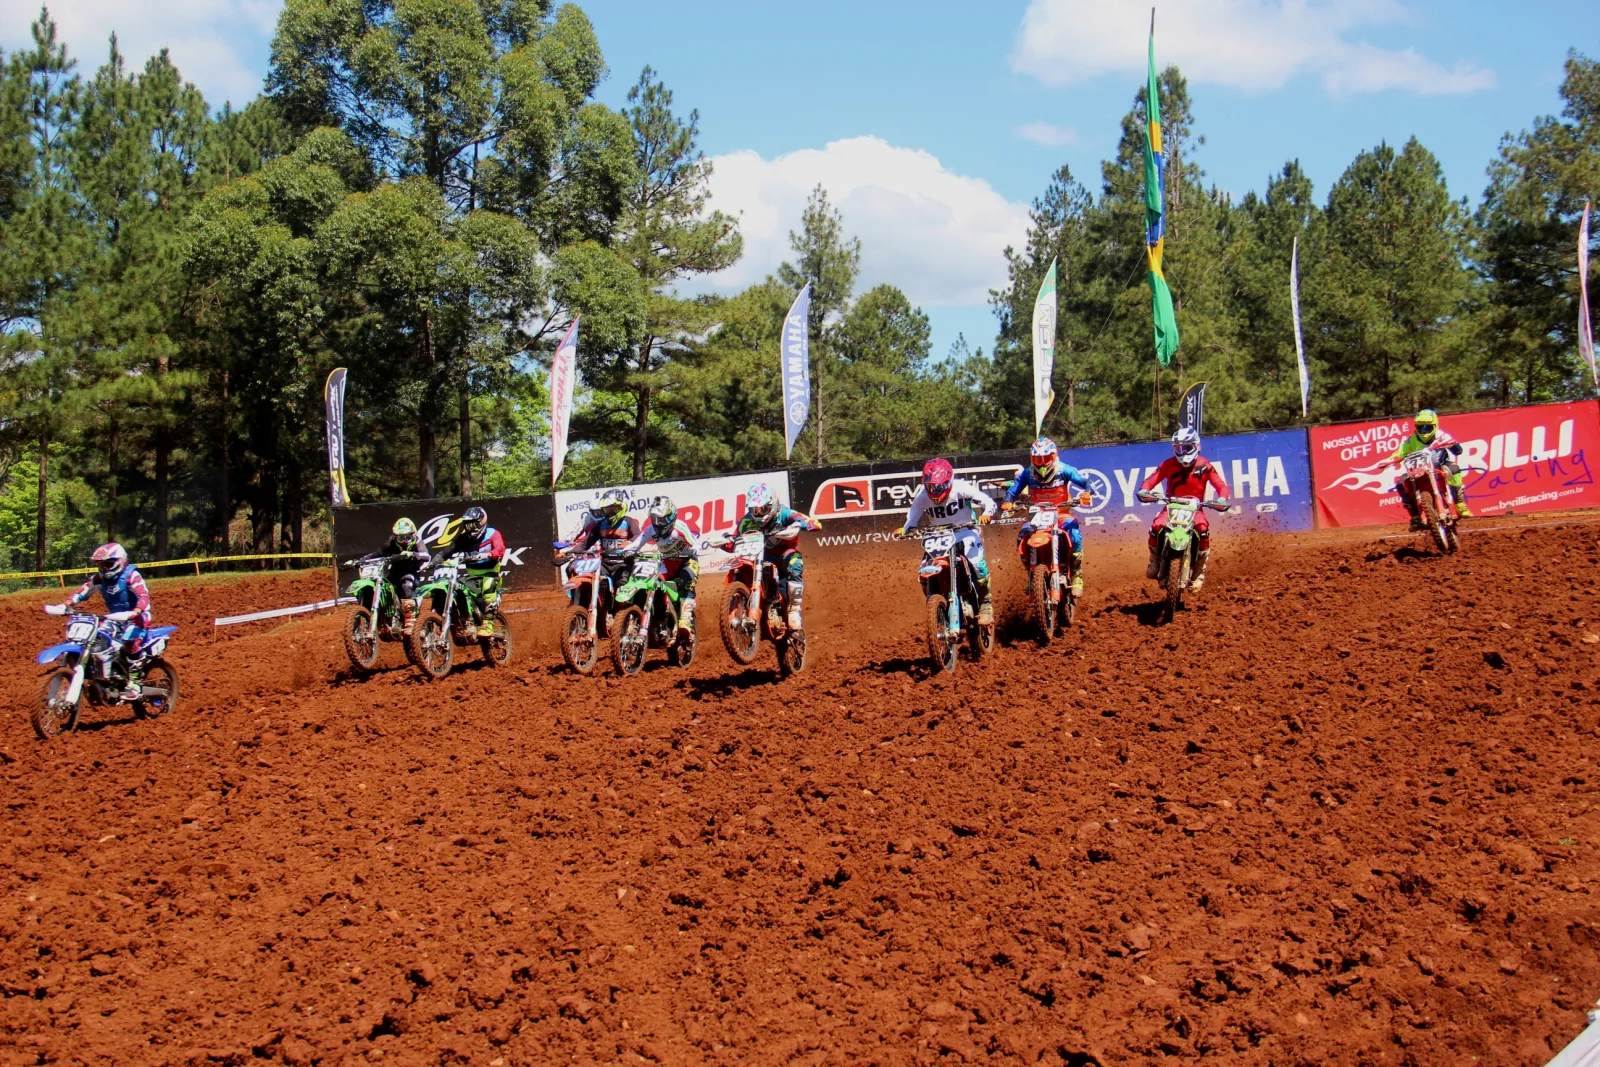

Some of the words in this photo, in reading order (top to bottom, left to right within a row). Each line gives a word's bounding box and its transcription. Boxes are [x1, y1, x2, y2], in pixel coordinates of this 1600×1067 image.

[787, 314, 805, 401] YAMAHA
[1322, 435, 1360, 450] NOSSA
[1359, 423, 1401, 443] VIDA
[1402, 421, 1409, 433] É
[1340, 443, 1373, 461] OFF
[1113, 456, 1290, 508] YAAHA
[565, 500, 591, 513] NOSS
[628, 497, 651, 512] AD!
[1379, 496, 1403, 507] PNEU
[1170, 508, 1193, 524] 262
[924, 537, 952, 553] 943
[575, 561, 598, 573] 217
[633, 562, 656, 574] 75
